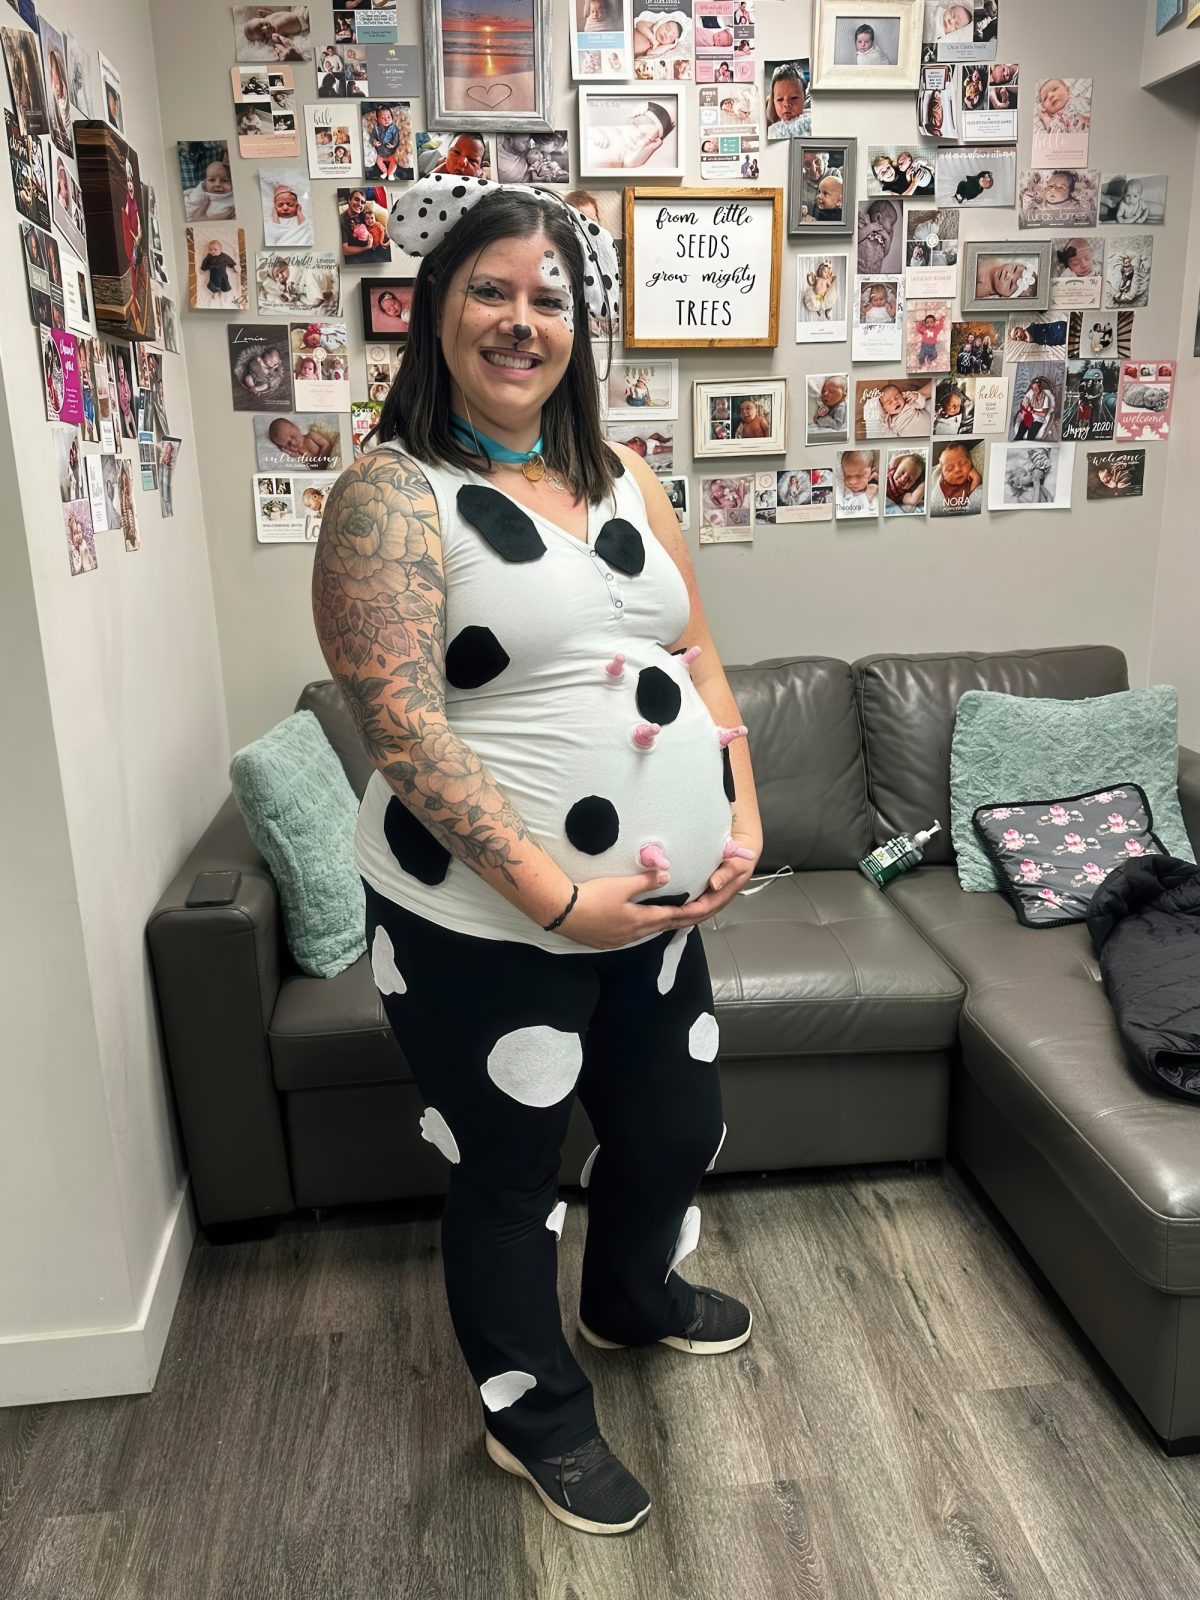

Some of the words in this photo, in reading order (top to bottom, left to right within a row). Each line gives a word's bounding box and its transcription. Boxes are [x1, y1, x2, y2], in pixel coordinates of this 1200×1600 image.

[656, 207, 699, 230] from
[713, 203, 753, 226] little
[676, 234, 730, 259] SEEDS
[645, 269, 691, 288] grow
[702, 263, 756, 294] mighty
[675, 299, 732, 326] TREES
[977, 384, 1004, 400] hello
[1122, 411, 1165, 424] welcome
[264, 451, 341, 469] introducing
[1090, 452, 1143, 467] welcome
[942, 490, 971, 507] NORA
